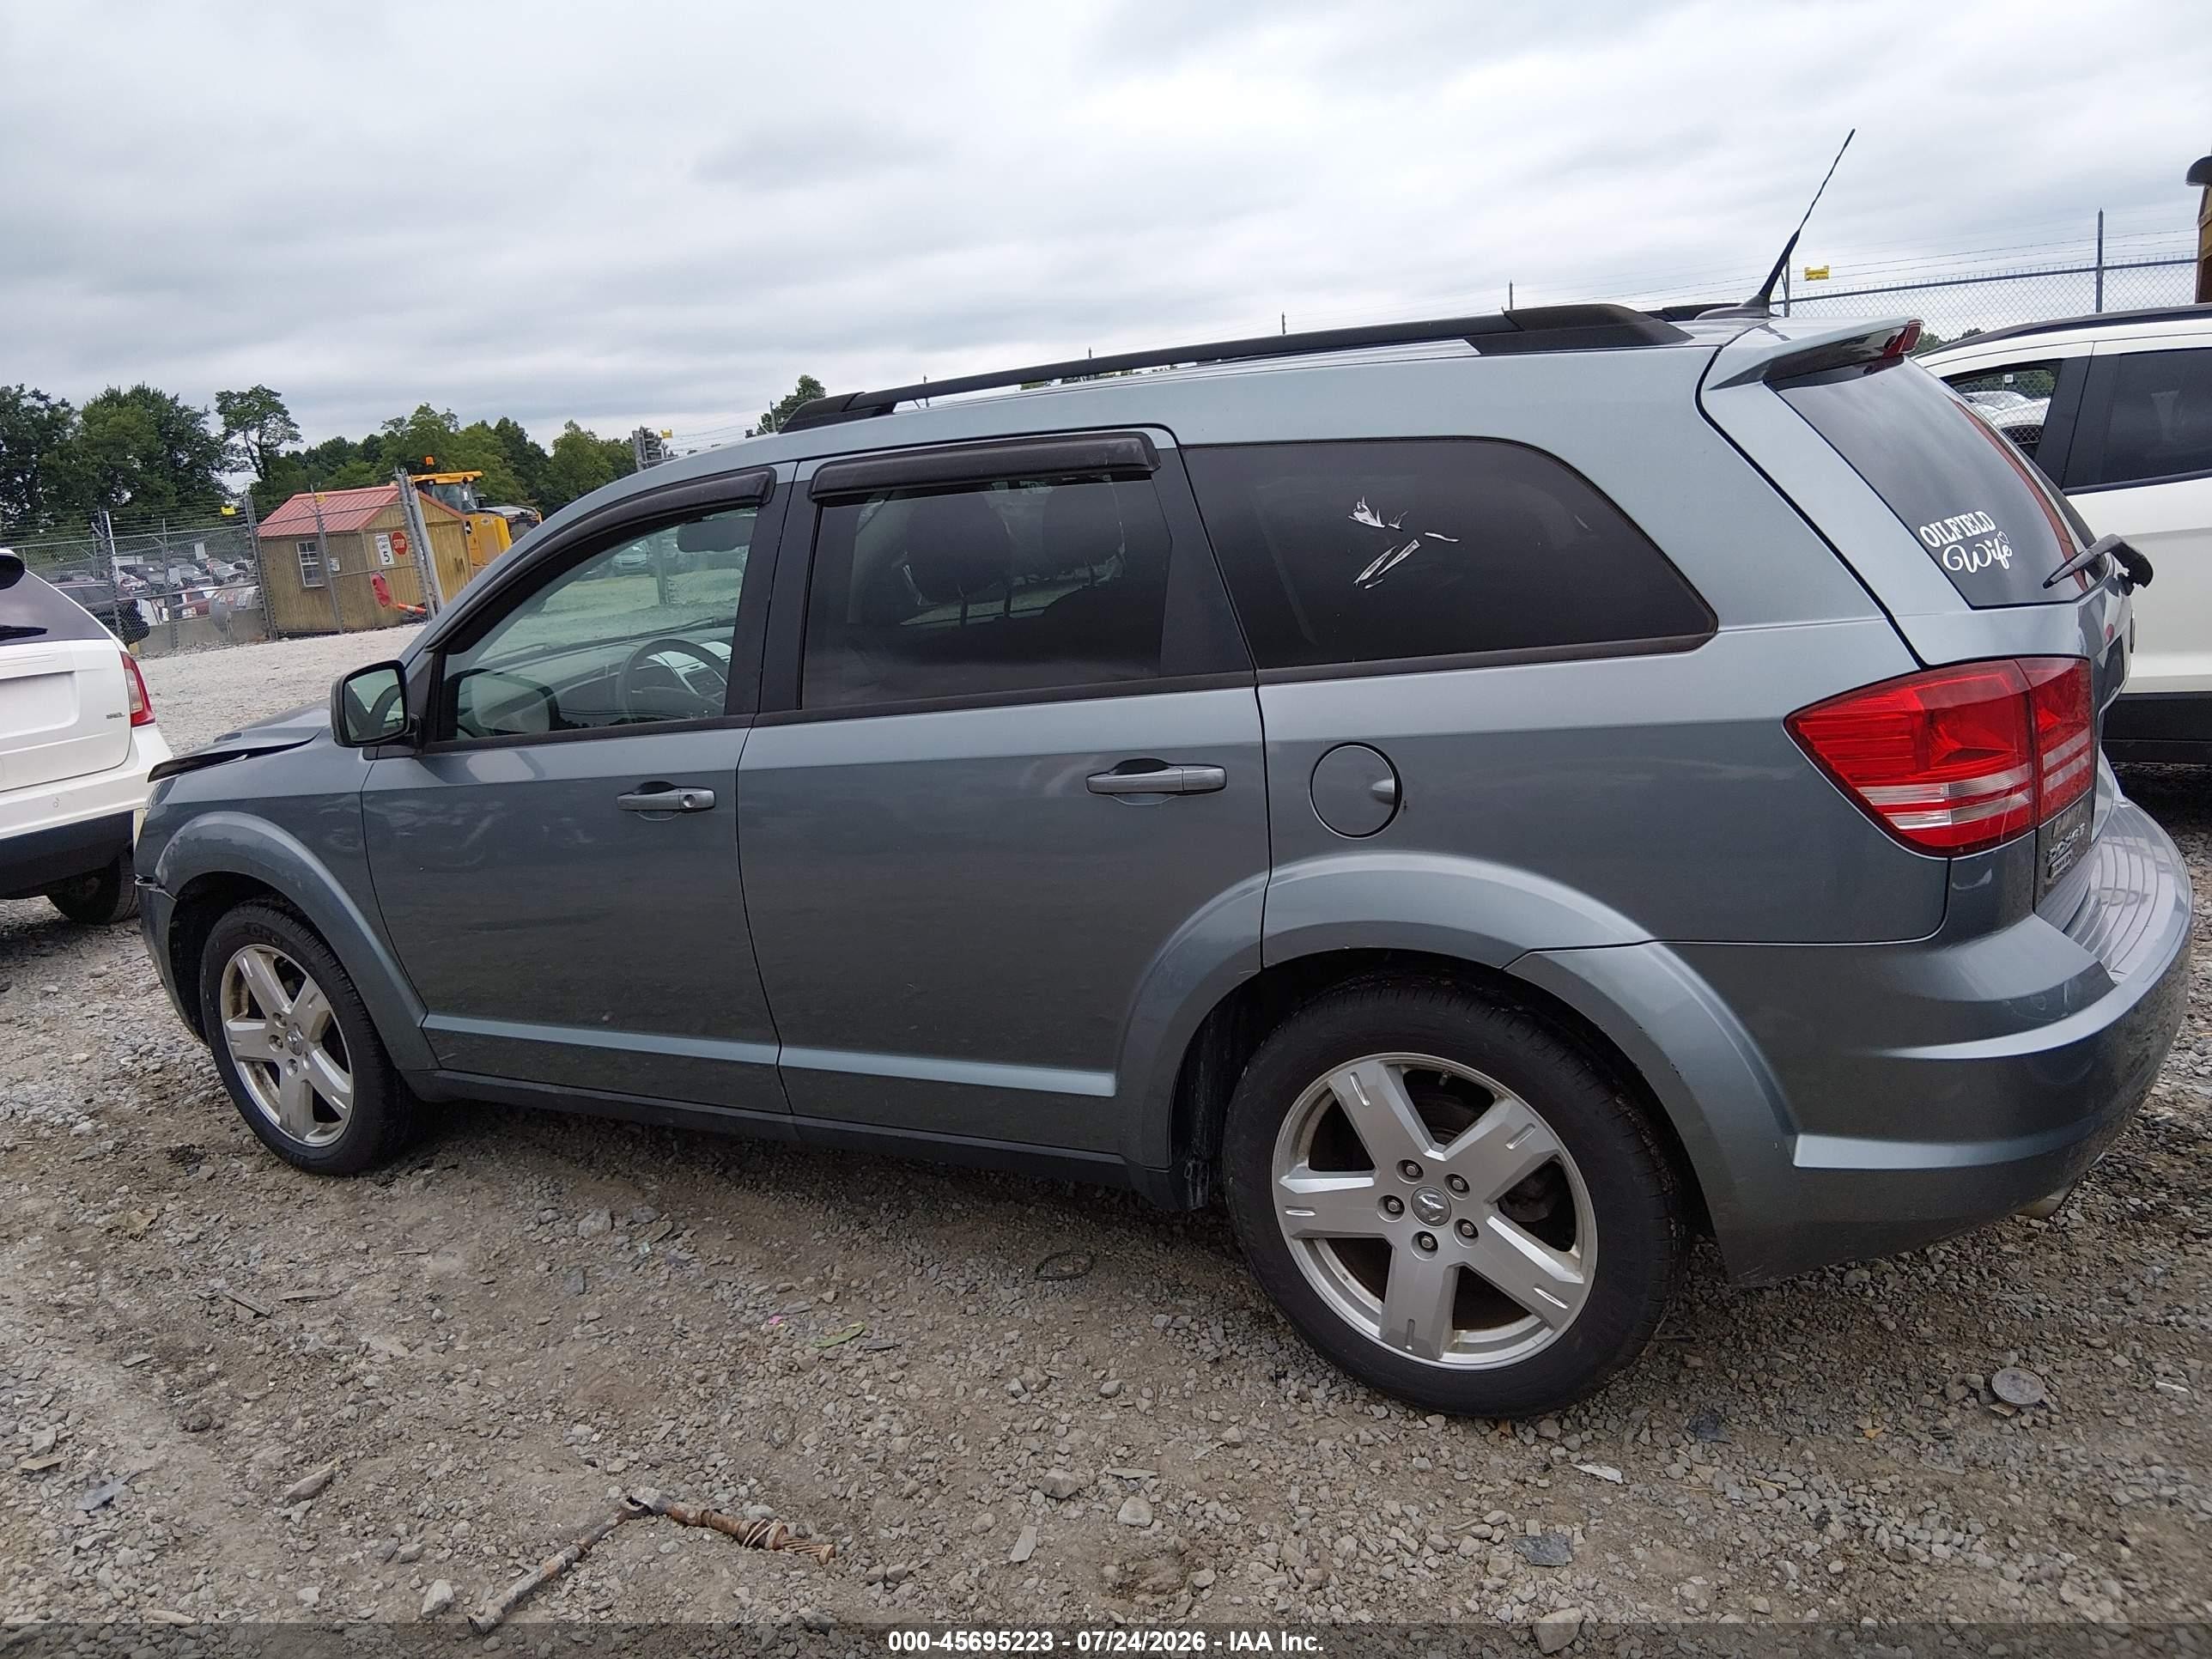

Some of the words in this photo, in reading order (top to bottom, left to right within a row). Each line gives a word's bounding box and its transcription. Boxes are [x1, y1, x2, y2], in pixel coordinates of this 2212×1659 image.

[1919, 510, 1996, 548] OILFIELD
[393, 538, 405, 549] STOP
[383, 550, 391, 562] 5
[1942, 538, 2013, 574] Wife
